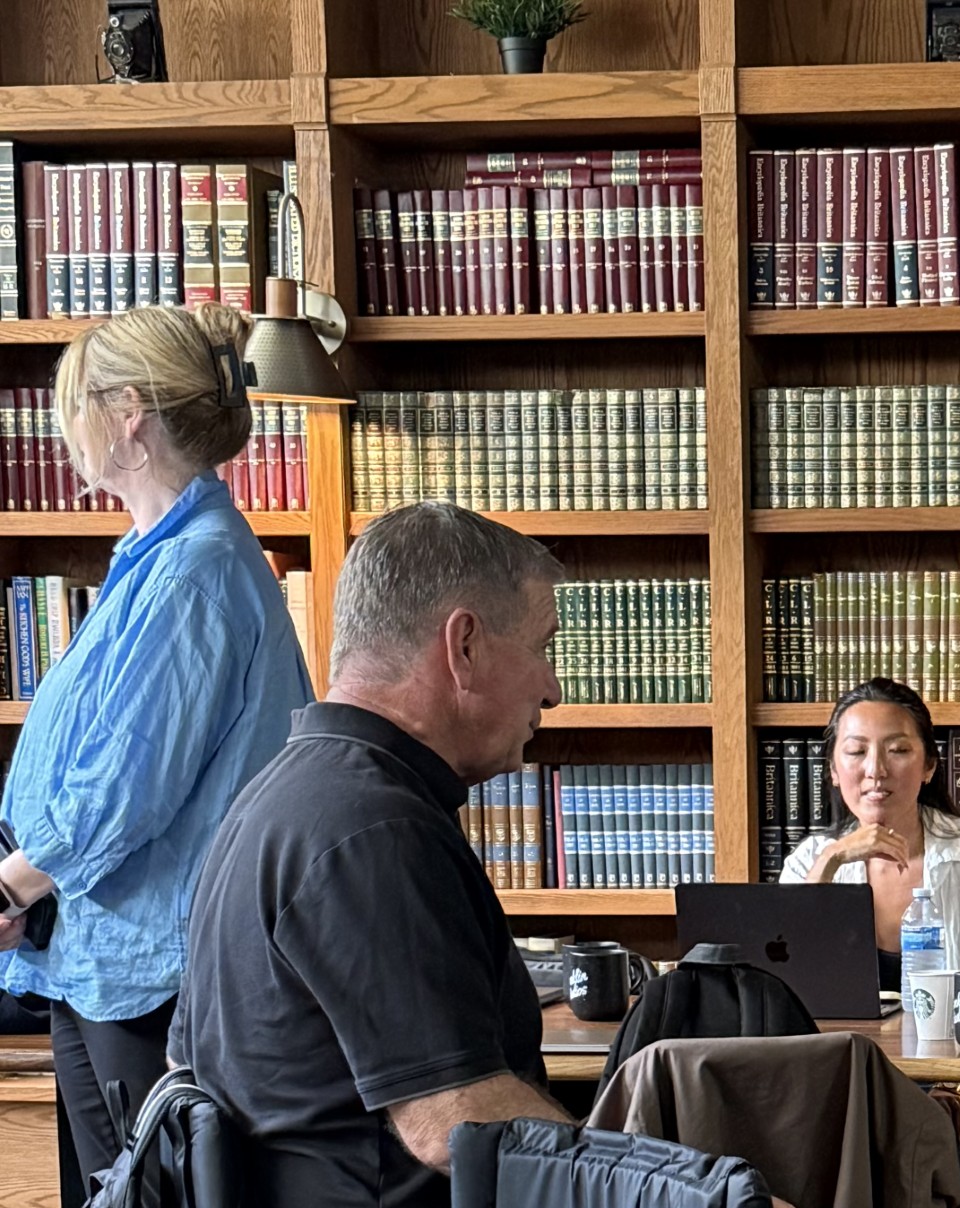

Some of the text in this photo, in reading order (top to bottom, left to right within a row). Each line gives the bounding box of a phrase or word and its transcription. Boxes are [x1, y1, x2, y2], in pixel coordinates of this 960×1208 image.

[20, 612, 28, 645] KITCHEN
[23, 670, 31, 686] WIFE
[766, 765, 776, 820] Britannica
[789, 765, 799, 820] Britannica
[813, 764, 822, 820] Britannica
